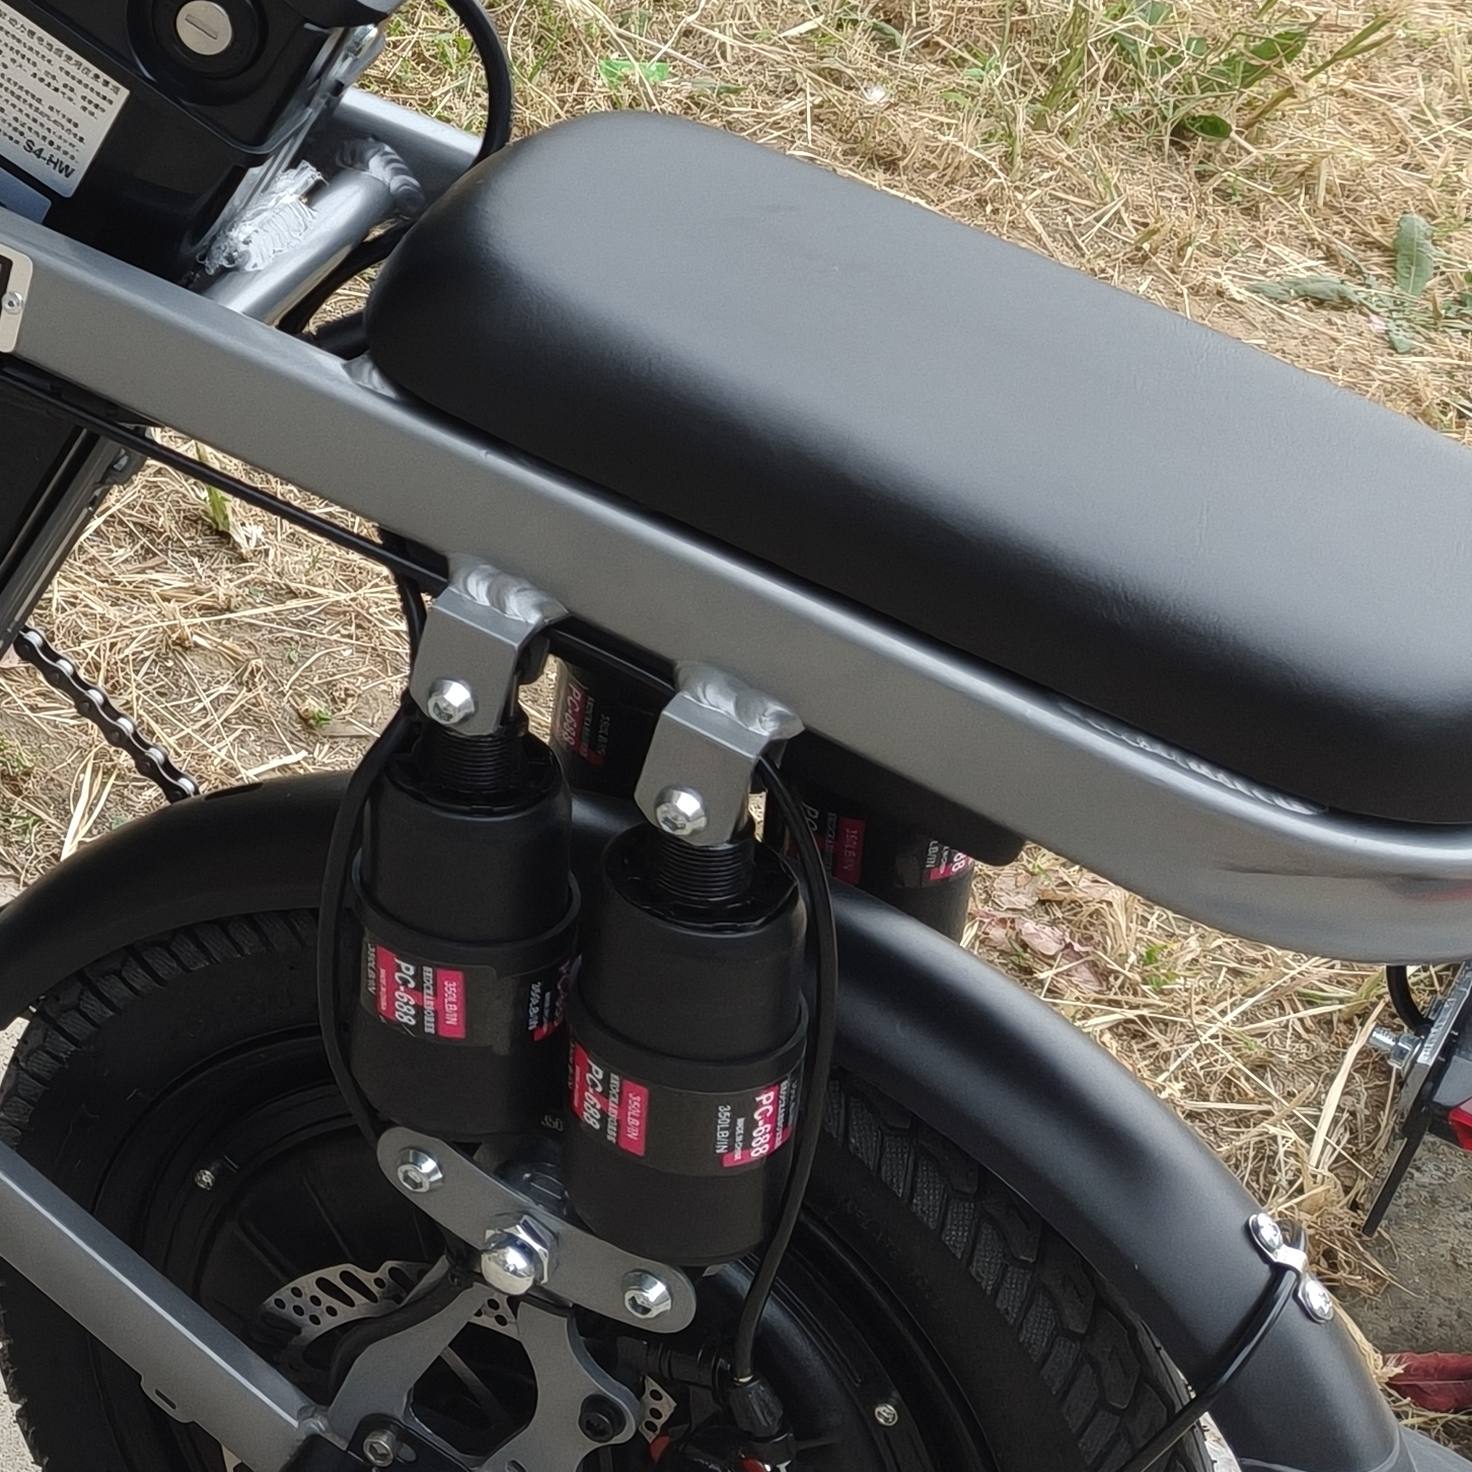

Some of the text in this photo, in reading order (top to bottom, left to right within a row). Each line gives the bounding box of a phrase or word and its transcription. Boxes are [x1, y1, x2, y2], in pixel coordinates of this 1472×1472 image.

[22, 139, 76, 179] S4-HW
[394, 957, 417, 1027] PC-688
[582, 1058, 604, 1131] PC-688
[751, 1091, 776, 1158] PC-688
[715, 1104, 732, 1155] 350LB/IN
